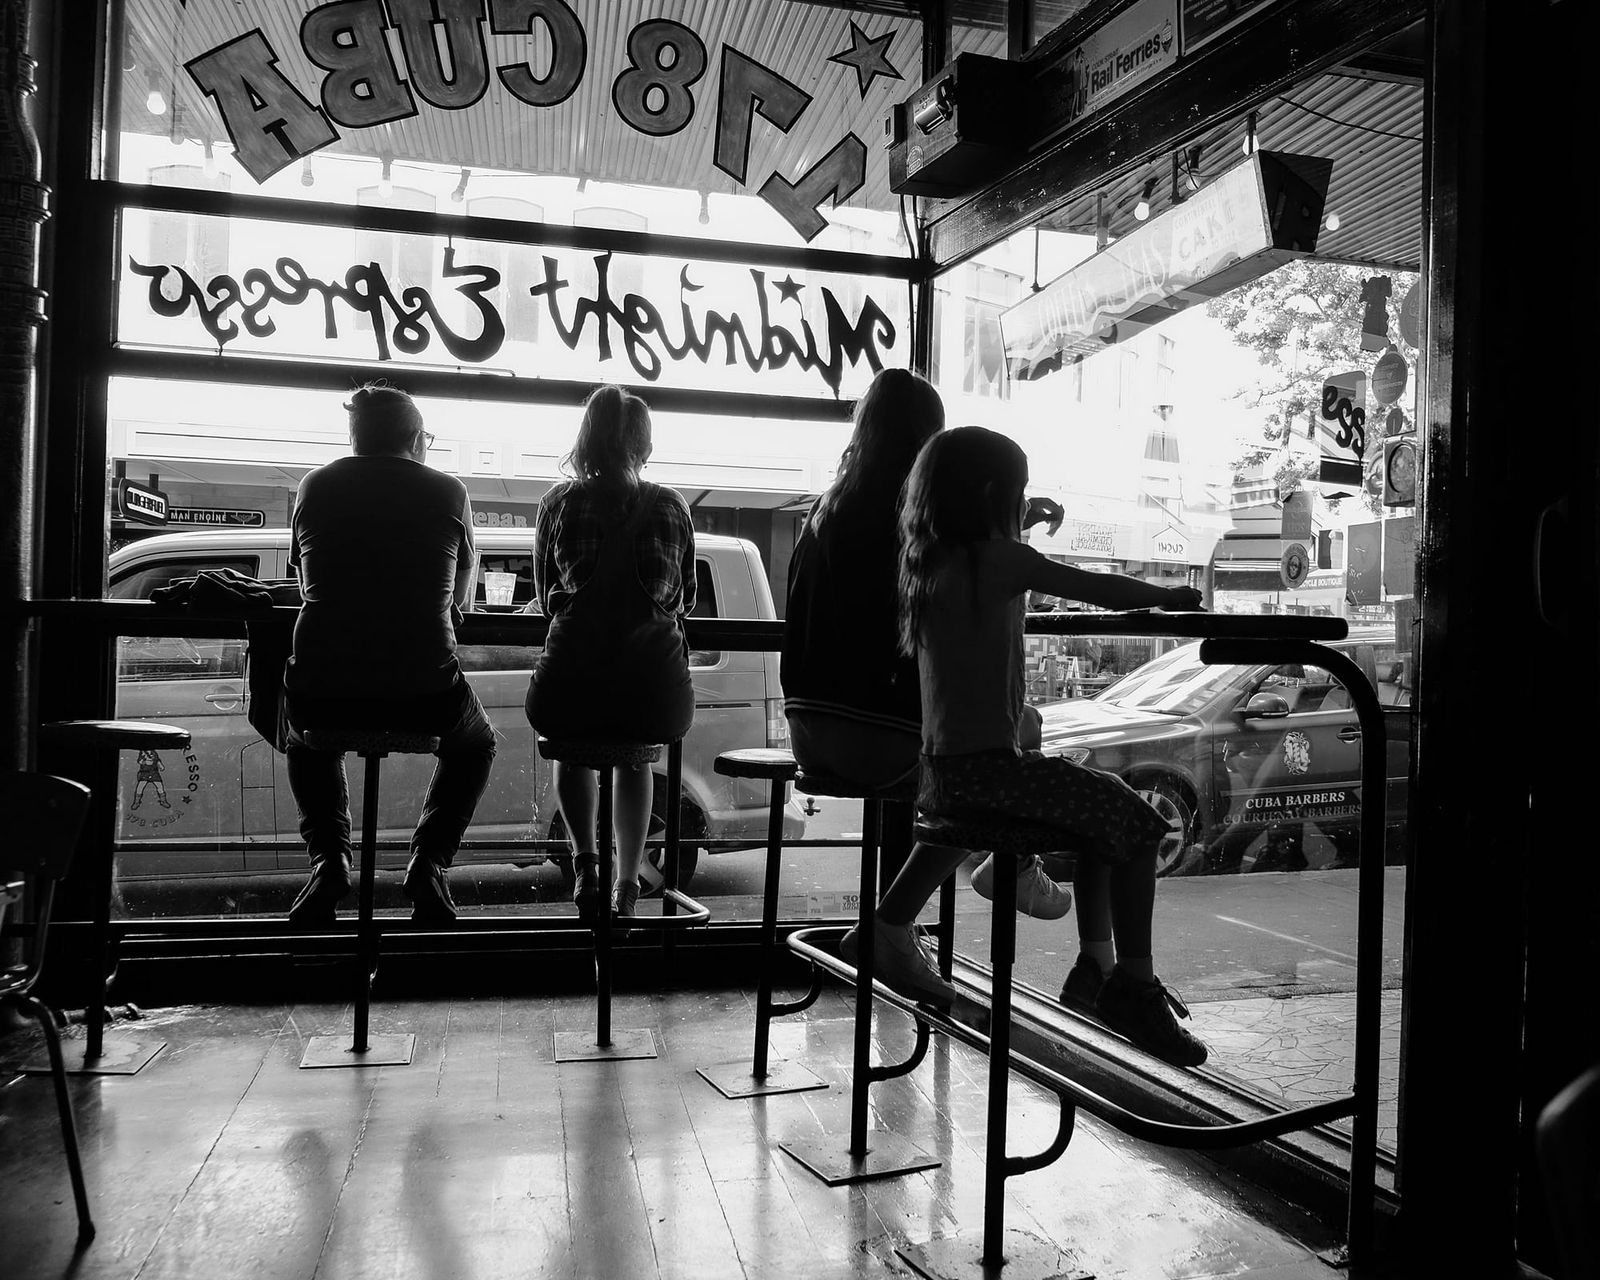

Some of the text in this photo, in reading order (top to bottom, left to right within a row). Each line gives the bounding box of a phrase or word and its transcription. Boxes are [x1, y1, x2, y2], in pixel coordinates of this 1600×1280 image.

[1091, 60, 1113, 94] Rail
[1116, 34, 1160, 78] Ferries
[193, 513, 227, 521] ENGINE
[1318, 577, 1343, 587] BOUTIQUE
[1245, 791, 1346, 809] CUBA BARBERS
[1222, 803, 1362, 826] COURTENAY BARBERS
